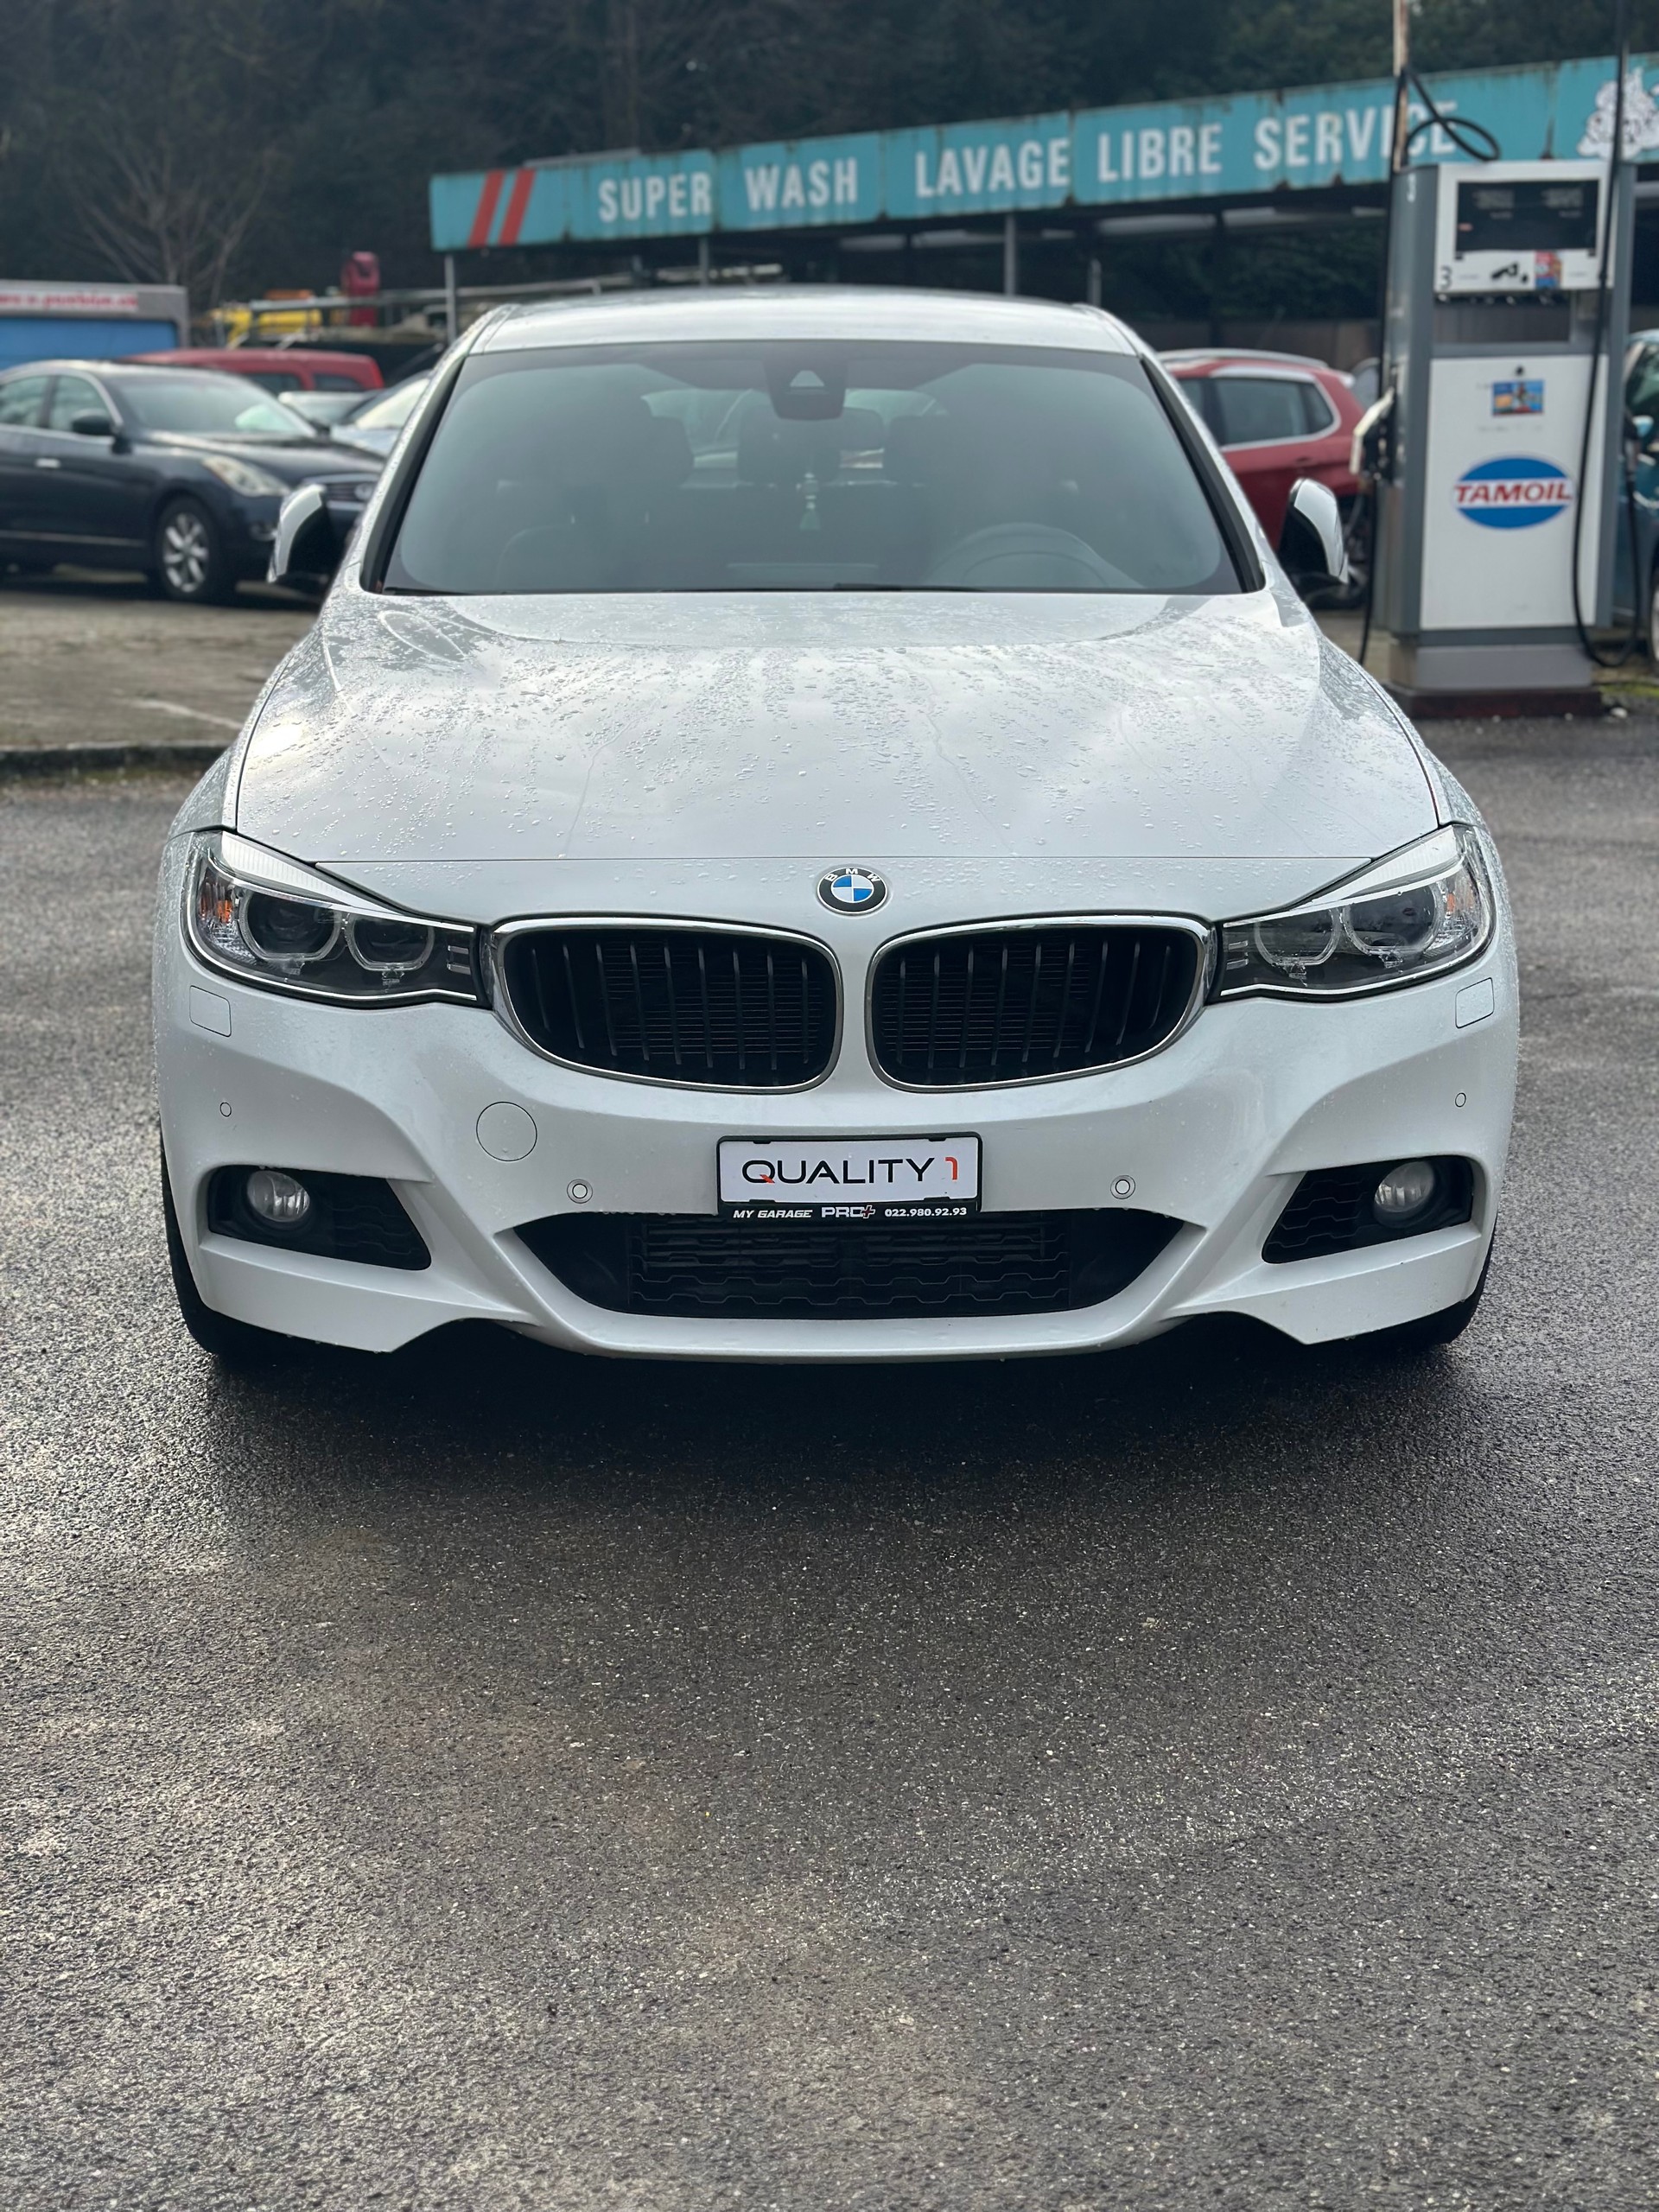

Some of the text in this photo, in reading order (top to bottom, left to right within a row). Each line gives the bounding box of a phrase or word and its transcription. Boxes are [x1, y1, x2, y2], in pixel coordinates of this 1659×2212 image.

[599, 172, 712, 223] SUPER
[744, 157, 858, 213] WASH
[915, 137, 1071, 198] LAVAGE
[1097, 123, 1223, 183] LIBRE
[1440, 265, 1452, 290] 3
[1454, 482, 1572, 504] TAMOIL
[823, 868, 880, 882] BMW
[741, 1156, 958, 1184] QUALITY 1
[733, 1210, 754, 1218] MY
[757, 1209, 813, 1218] GARAGE
[884, 1207, 967, 1217] 022.980.92.93
